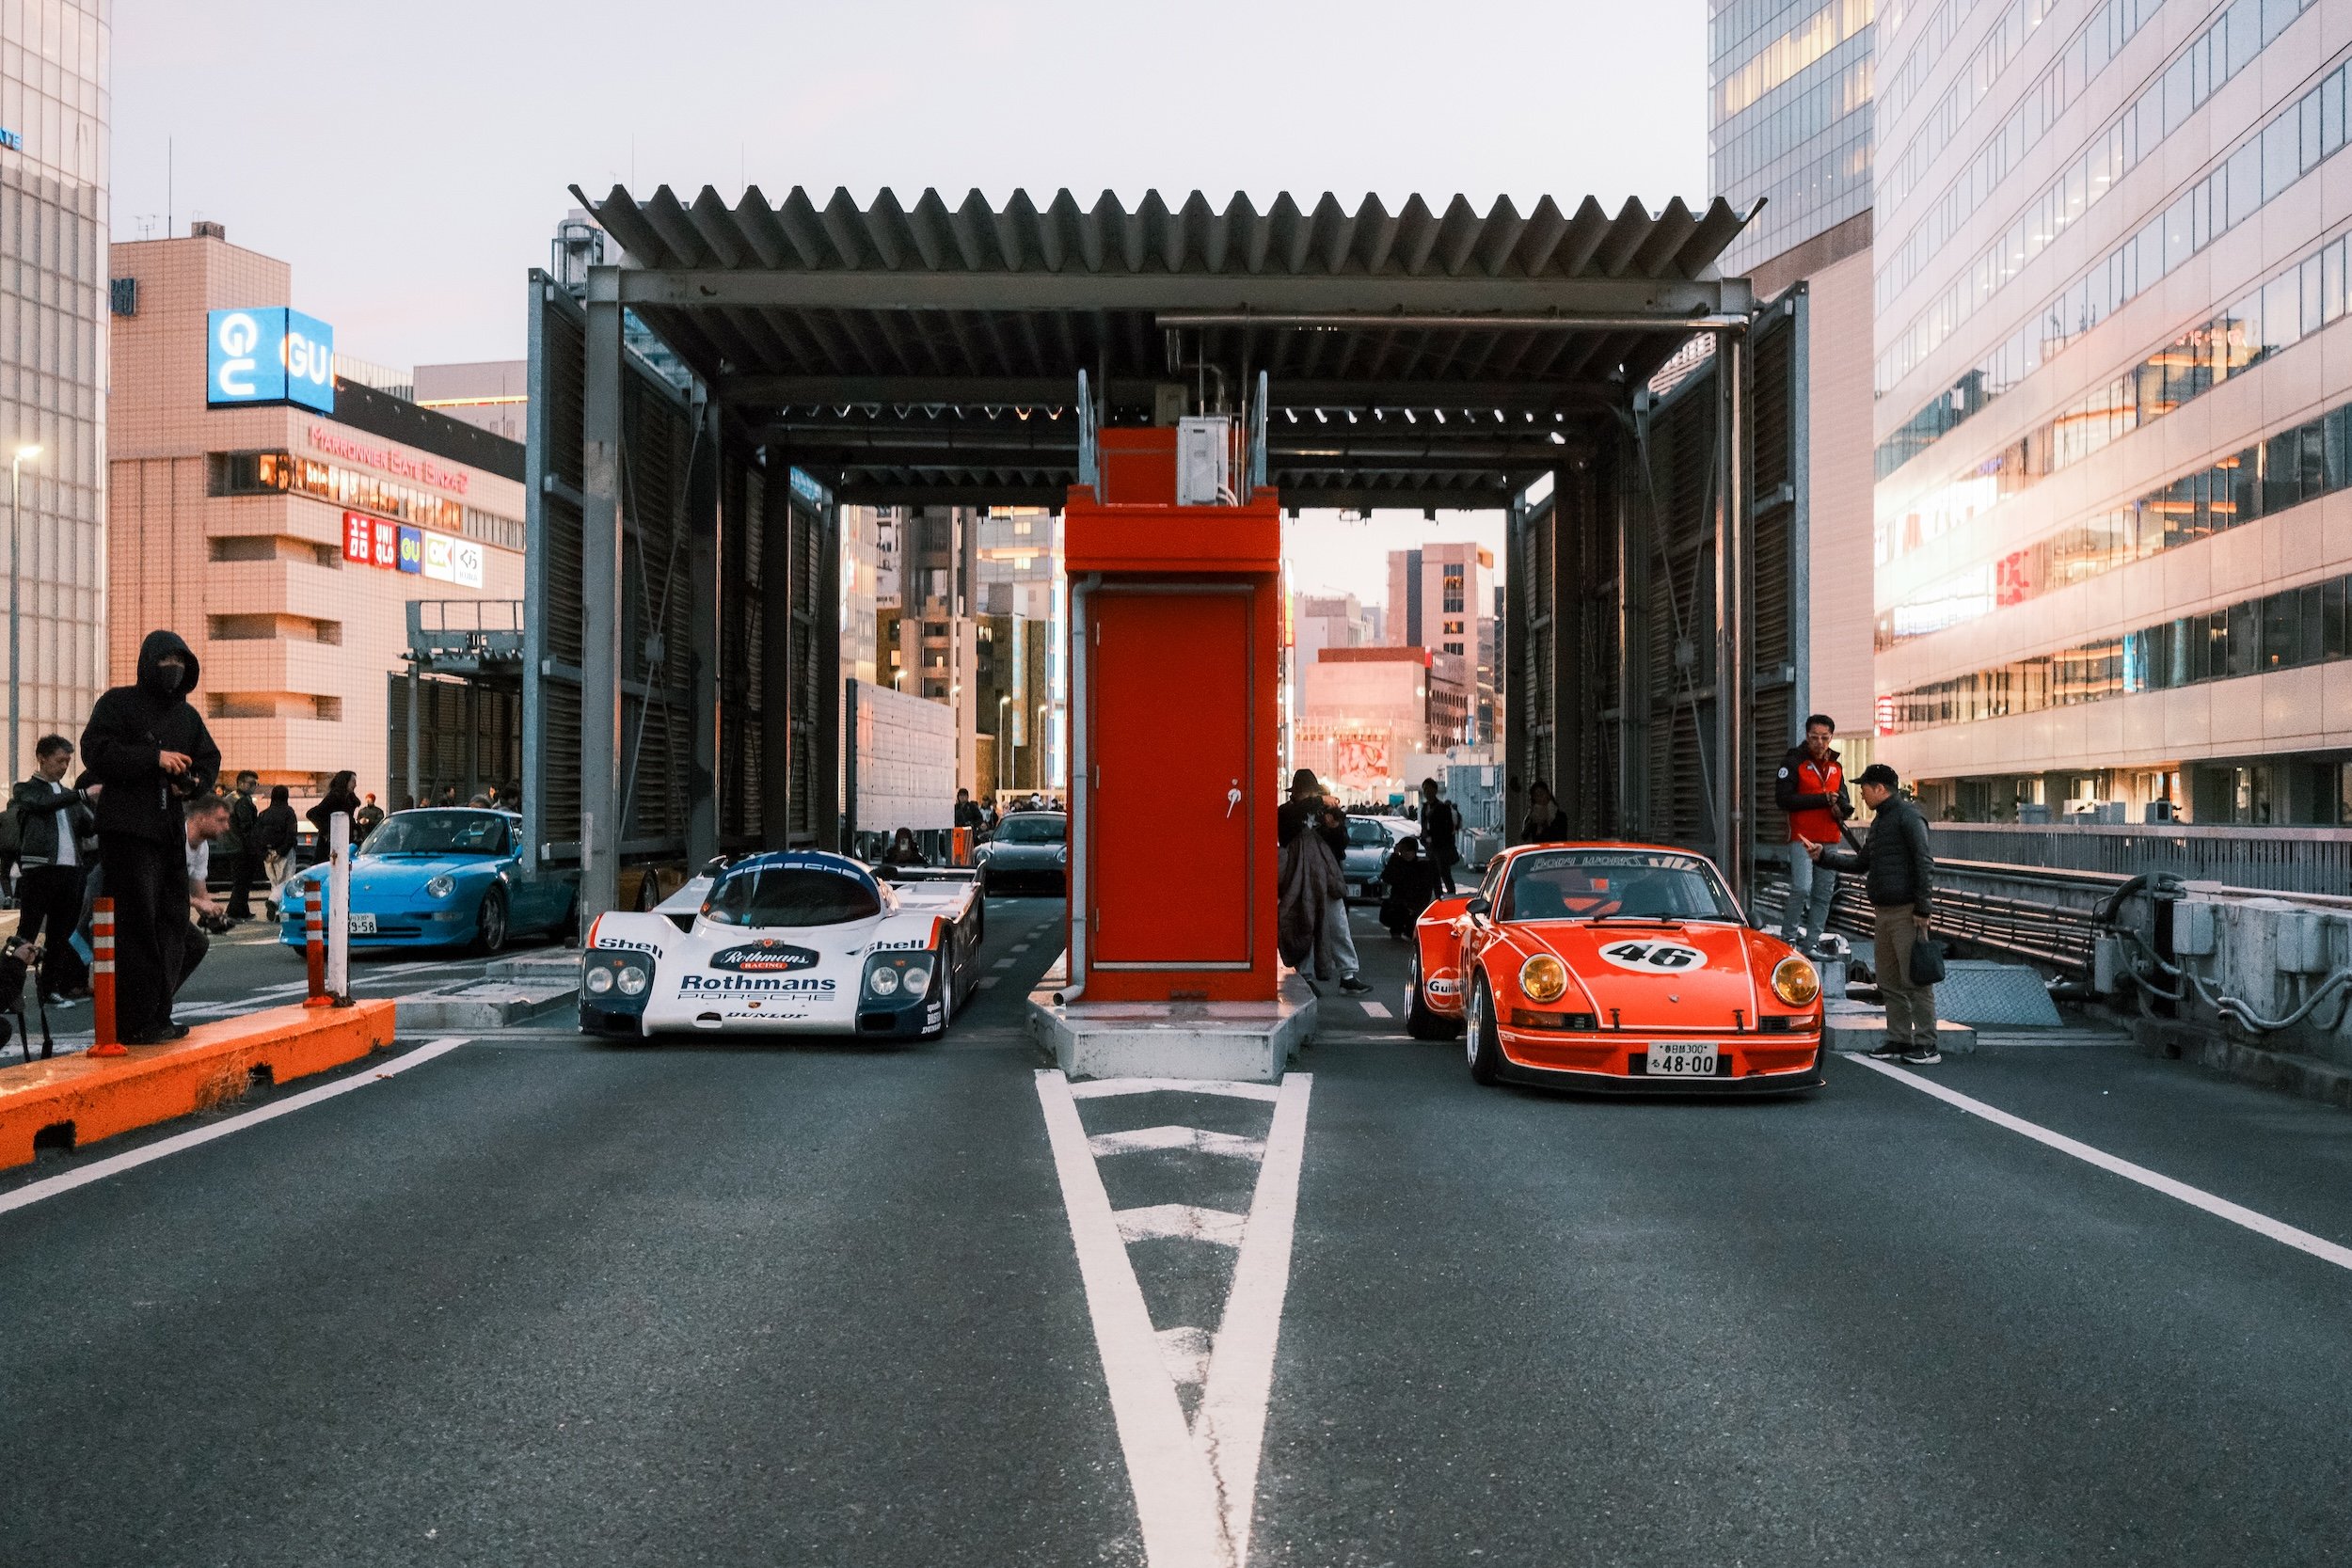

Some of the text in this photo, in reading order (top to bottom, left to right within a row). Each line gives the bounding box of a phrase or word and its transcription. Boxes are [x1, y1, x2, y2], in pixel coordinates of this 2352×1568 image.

[219, 312, 257, 396] GU
[279, 332, 326, 385] GU
[376, 524, 392, 546] UNI
[376, 542, 394, 564] QLO
[401, 537, 421, 563] GU
[460, 549, 477, 569] くら
[726, 863, 861, 880] PORSCHE
[350, 921, 374, 932] 9-58
[598, 938, 663, 959] Shell
[721, 950, 809, 964] Rothmans
[864, 940, 924, 958] Shell
[1606, 943, 1697, 968] 46
[680, 974, 836, 990] Rothmans
[677, 993, 836, 1002] PORSCHE
[1662, 1055, 1713, 1072] 48-00
